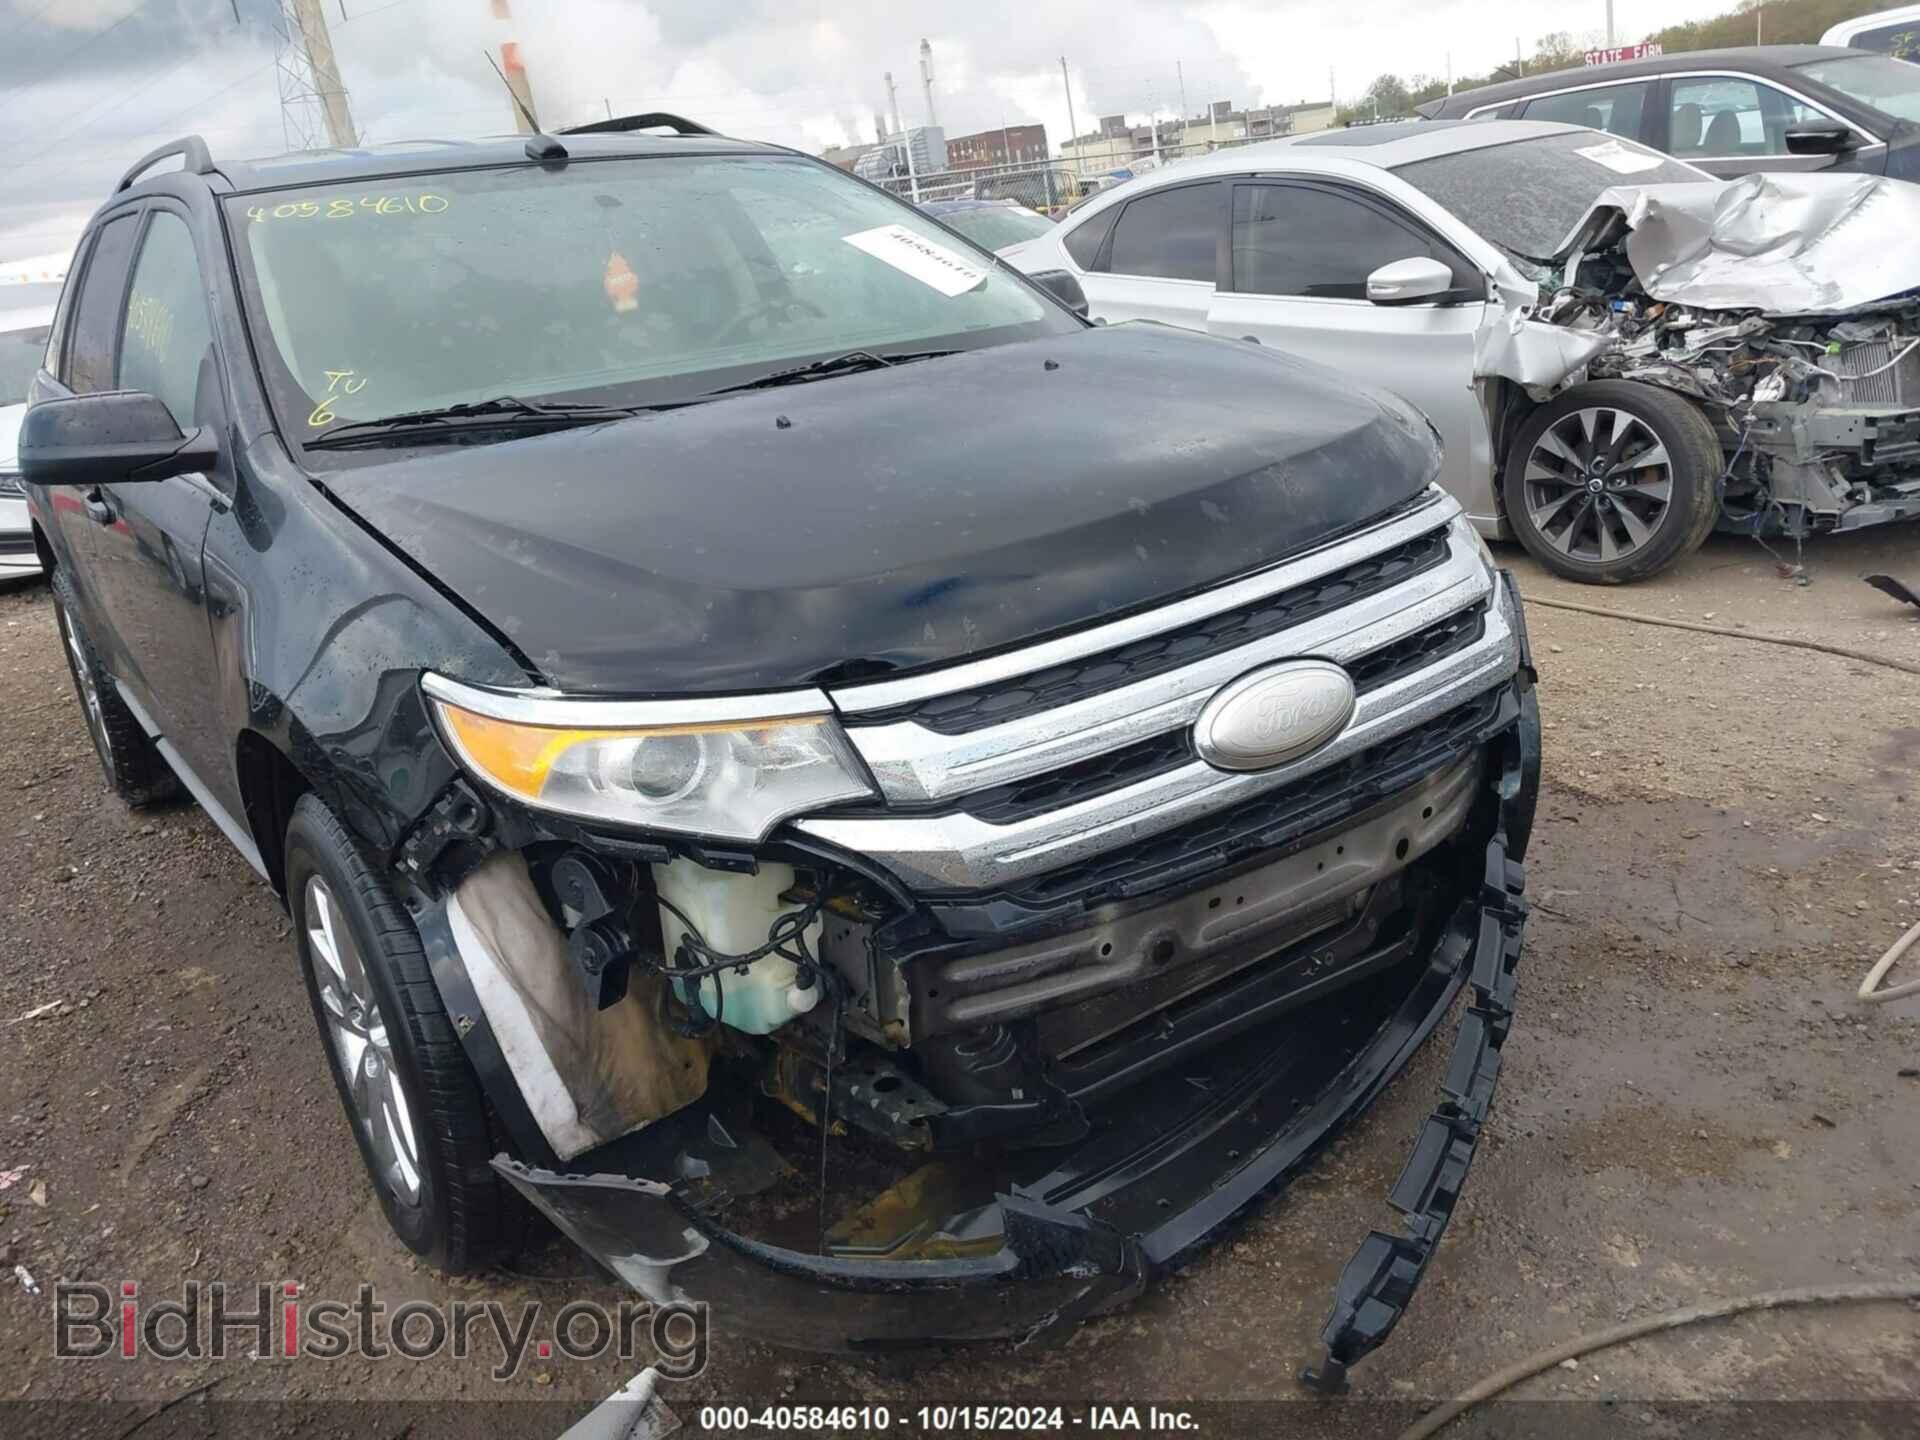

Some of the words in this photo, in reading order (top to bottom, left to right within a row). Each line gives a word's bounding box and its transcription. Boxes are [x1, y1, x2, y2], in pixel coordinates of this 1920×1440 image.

[1585, 49, 1622, 66] STATE
[1633, 43, 1663, 59] FARM
[248, 192, 449, 222] 40584610
[307, 396, 338, 426] 6
[1254, 689, 1336, 741] Ford
